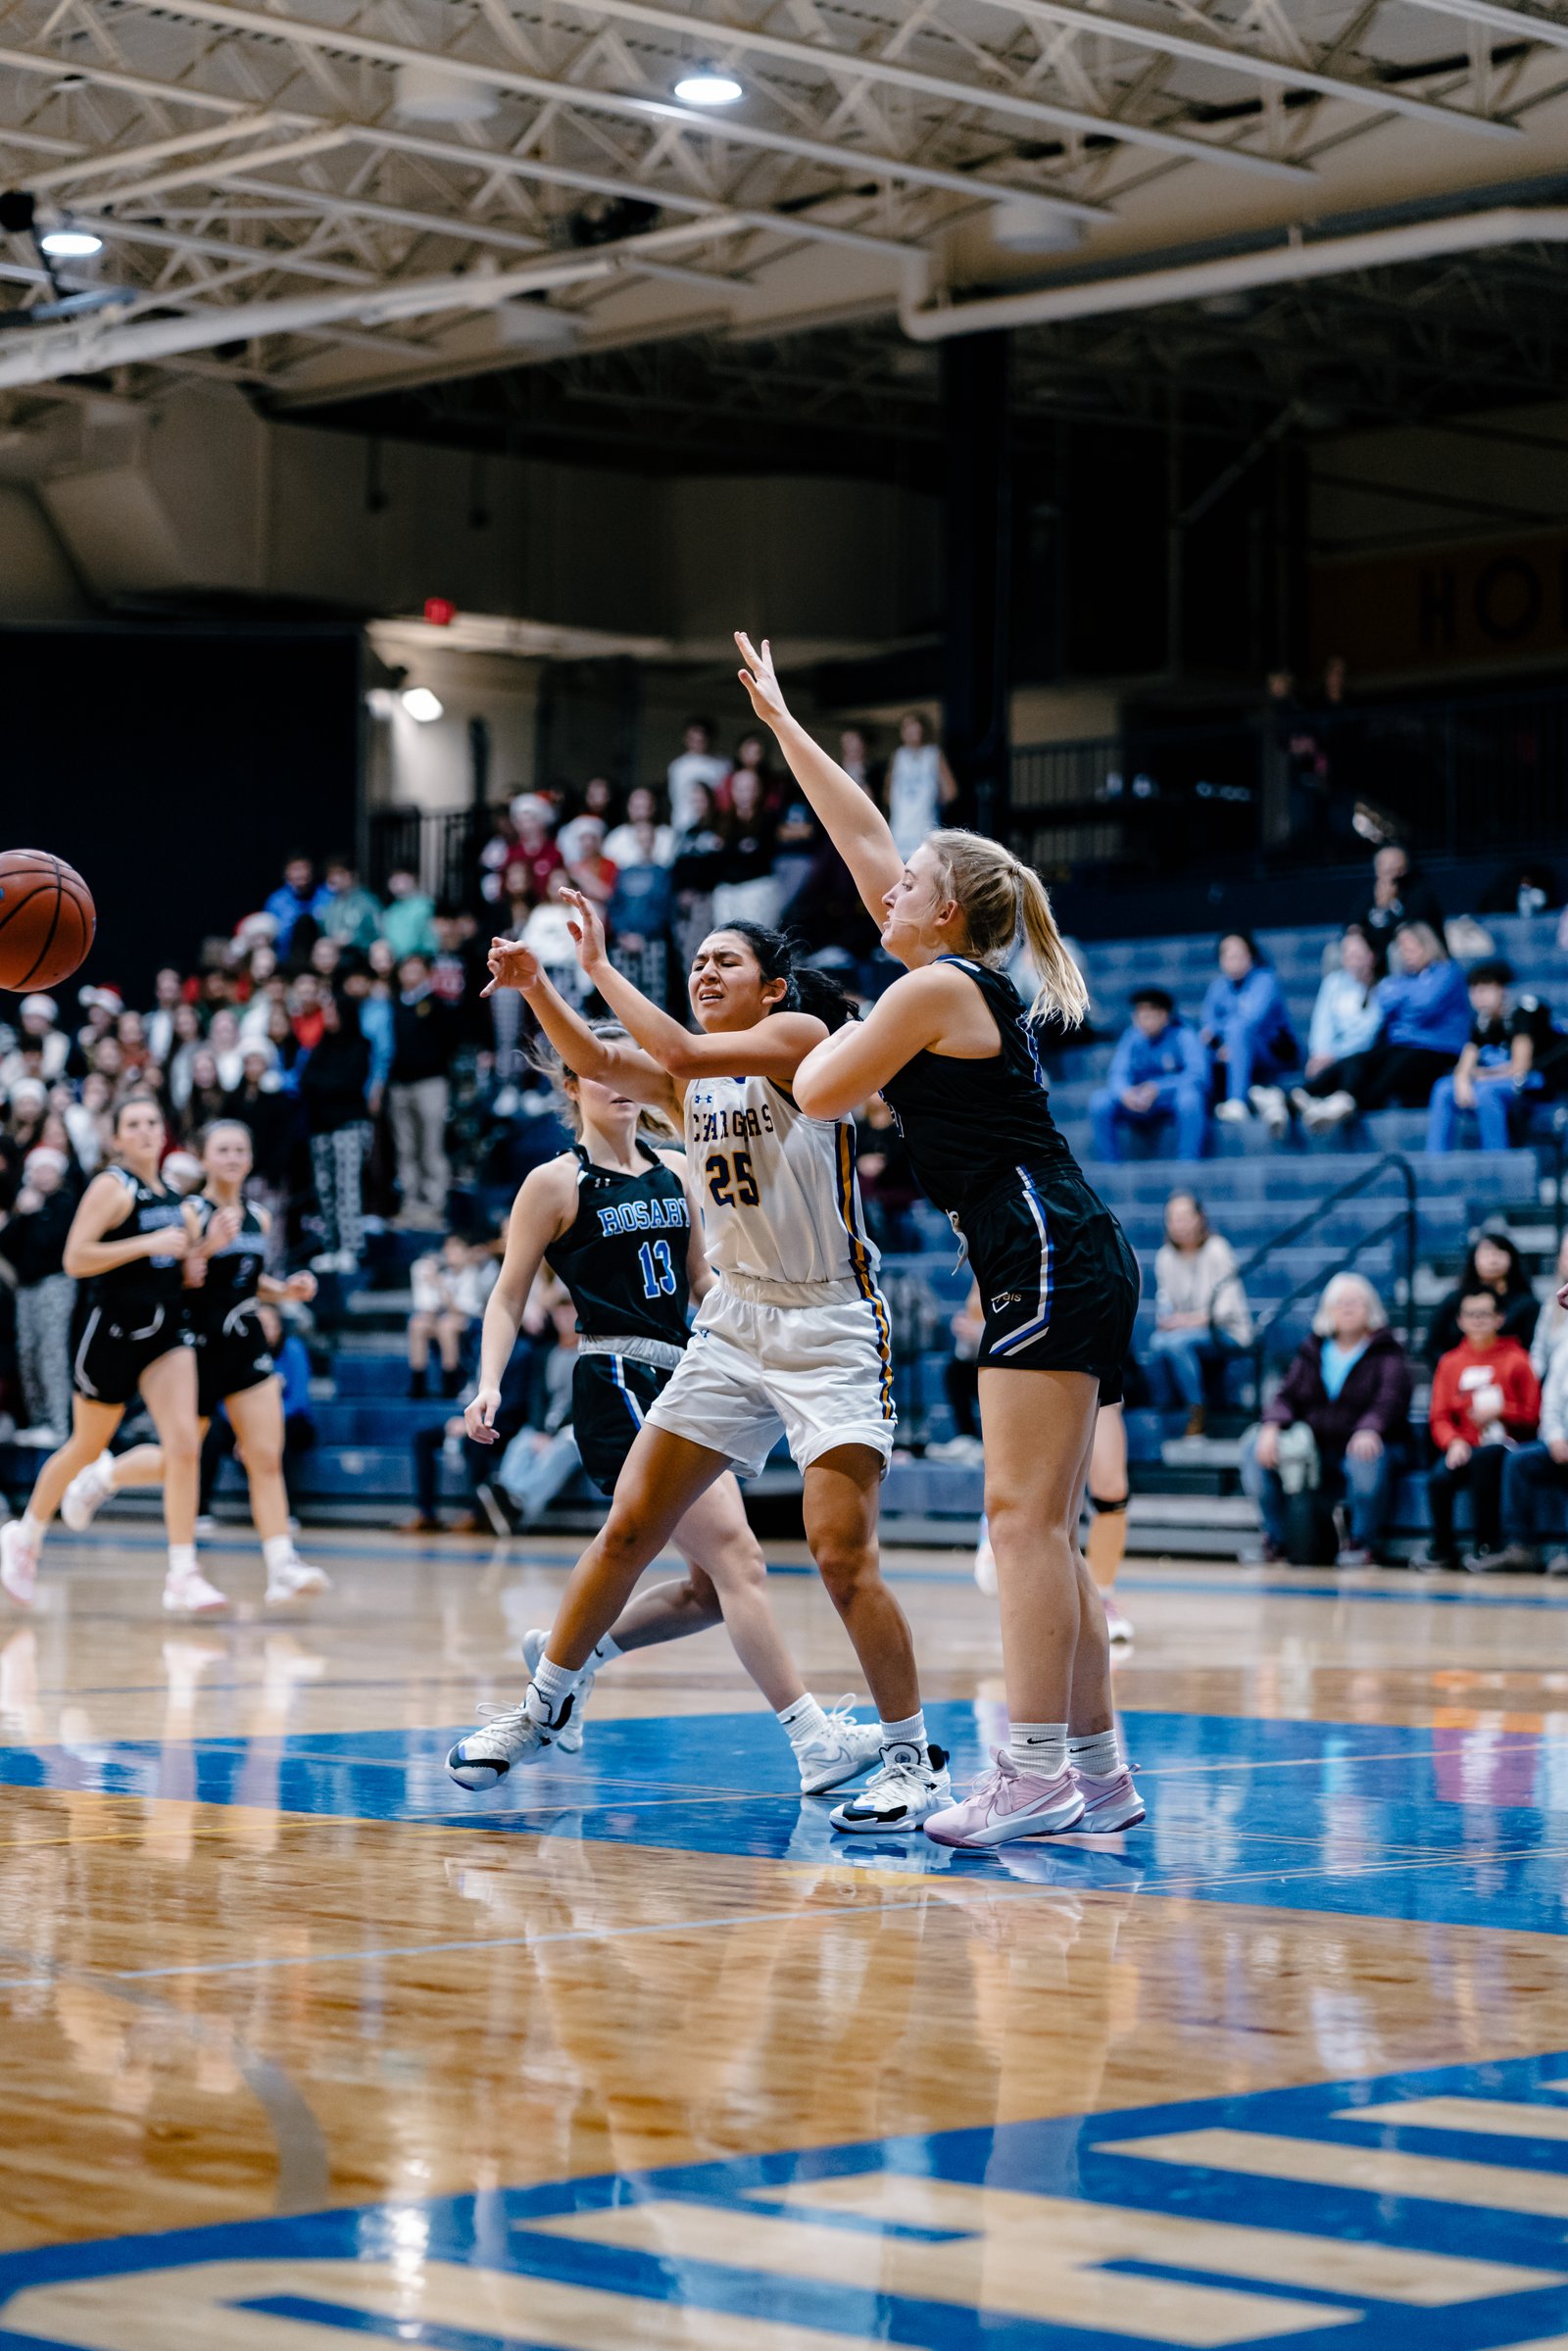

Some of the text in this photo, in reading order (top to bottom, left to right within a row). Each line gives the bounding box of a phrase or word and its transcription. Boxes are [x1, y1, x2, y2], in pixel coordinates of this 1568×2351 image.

[1418, 550, 1568, 647] HO
[705, 1151, 760, 1208] 25
[638, 1239, 678, 1299] 13
